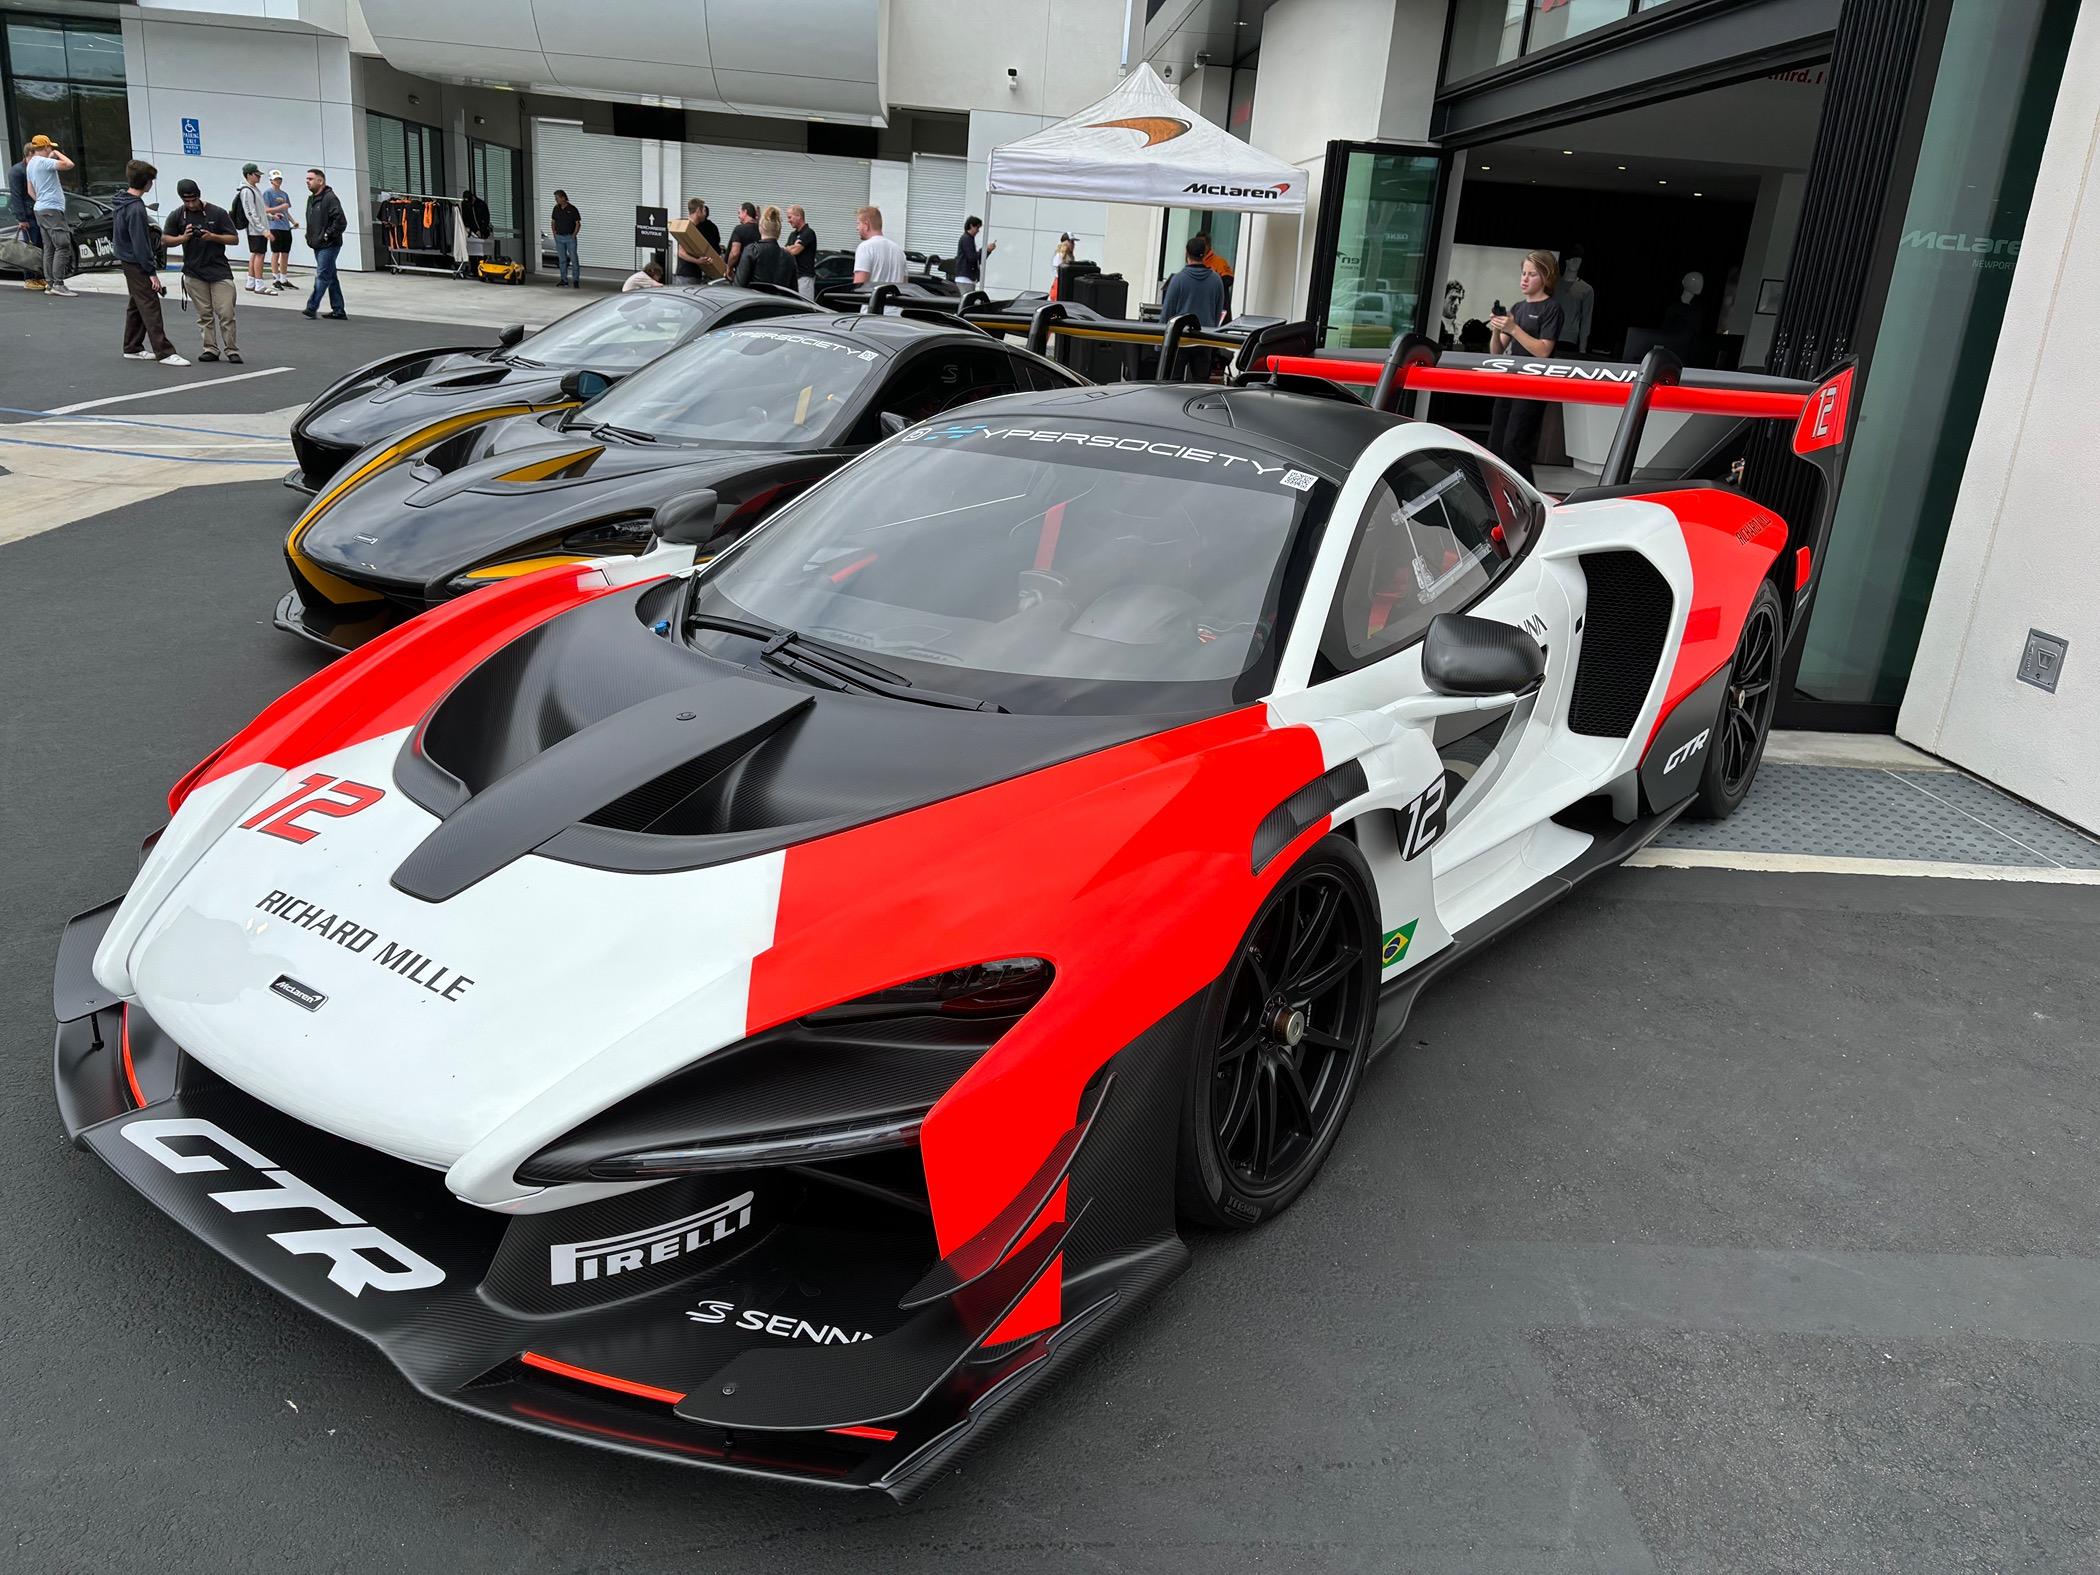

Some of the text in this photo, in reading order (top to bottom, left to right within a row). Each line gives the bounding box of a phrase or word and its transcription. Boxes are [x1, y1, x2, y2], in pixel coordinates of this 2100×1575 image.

[1182, 183, 1278, 199] McLaren
[1901, 230, 2020, 255] McLare
[1517, 363, 1638, 383] SENN
[1811, 385, 1838, 439] 12
[1663, 727, 1710, 775] GTR
[237, 773, 386, 845] 12
[1402, 774, 1446, 861] 12
[255, 889, 475, 1002] RICHARD MILLE
[275, 980, 318, 1004] McLaren
[120, 1118, 446, 1298] GTR
[550, 1190, 755, 1286] PIRELLI
